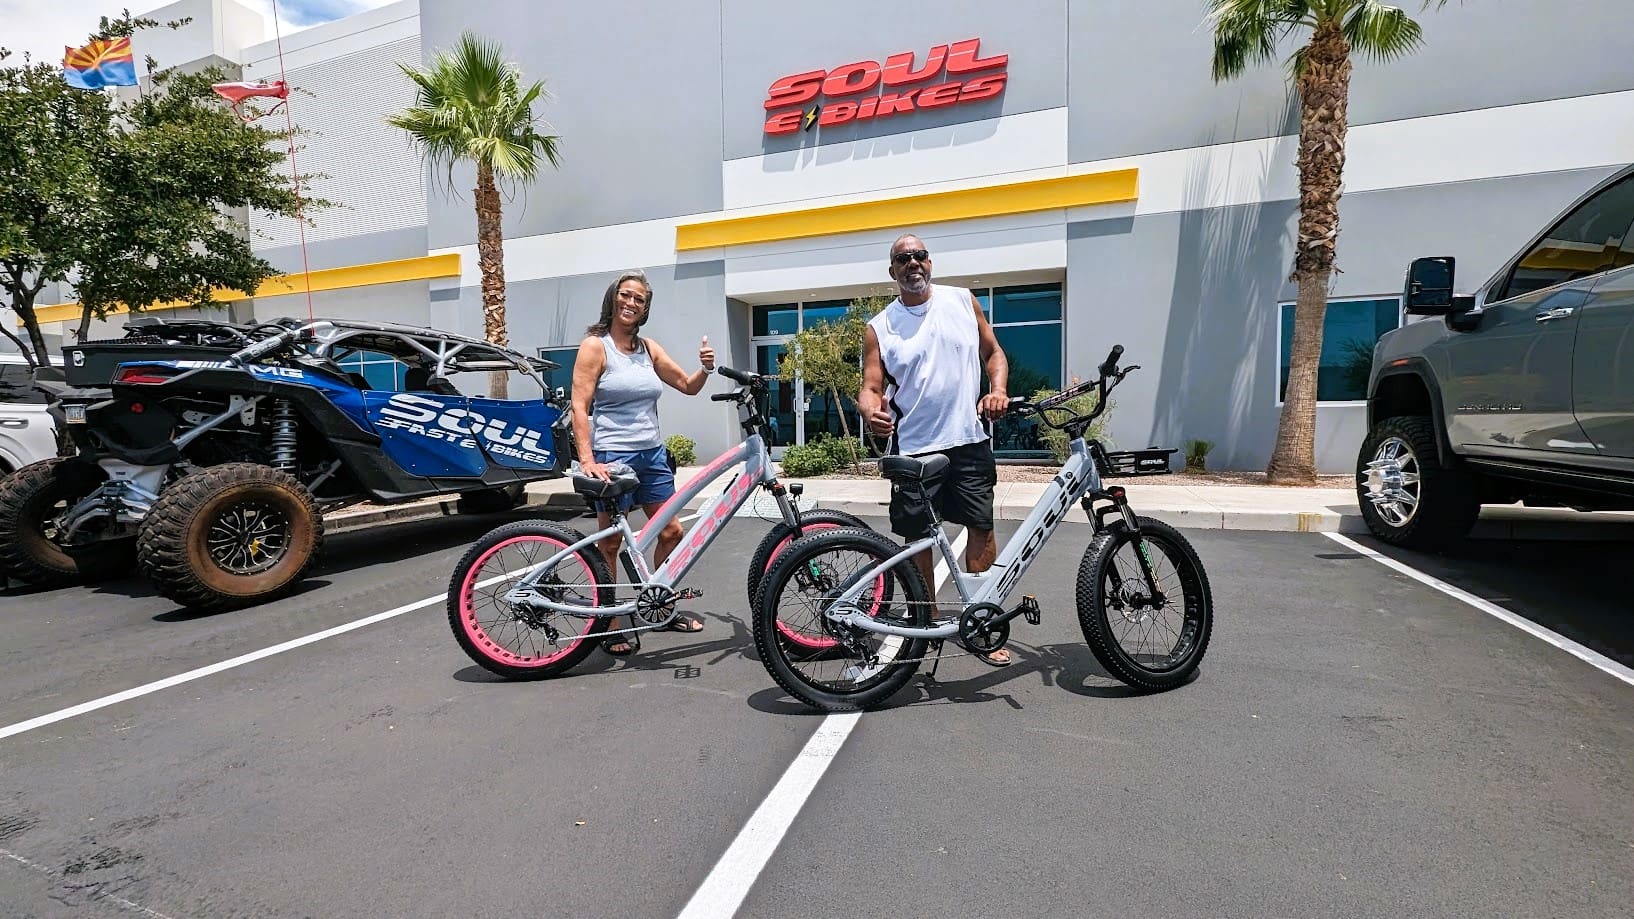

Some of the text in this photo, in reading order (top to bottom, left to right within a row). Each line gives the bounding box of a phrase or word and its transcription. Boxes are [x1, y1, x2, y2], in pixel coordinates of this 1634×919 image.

[764, 37, 1008, 112] SOUL
[379, 393, 551, 456] SOUL
[666, 472, 752, 580] SOUL
[996, 476, 1080, 598] SOUL
